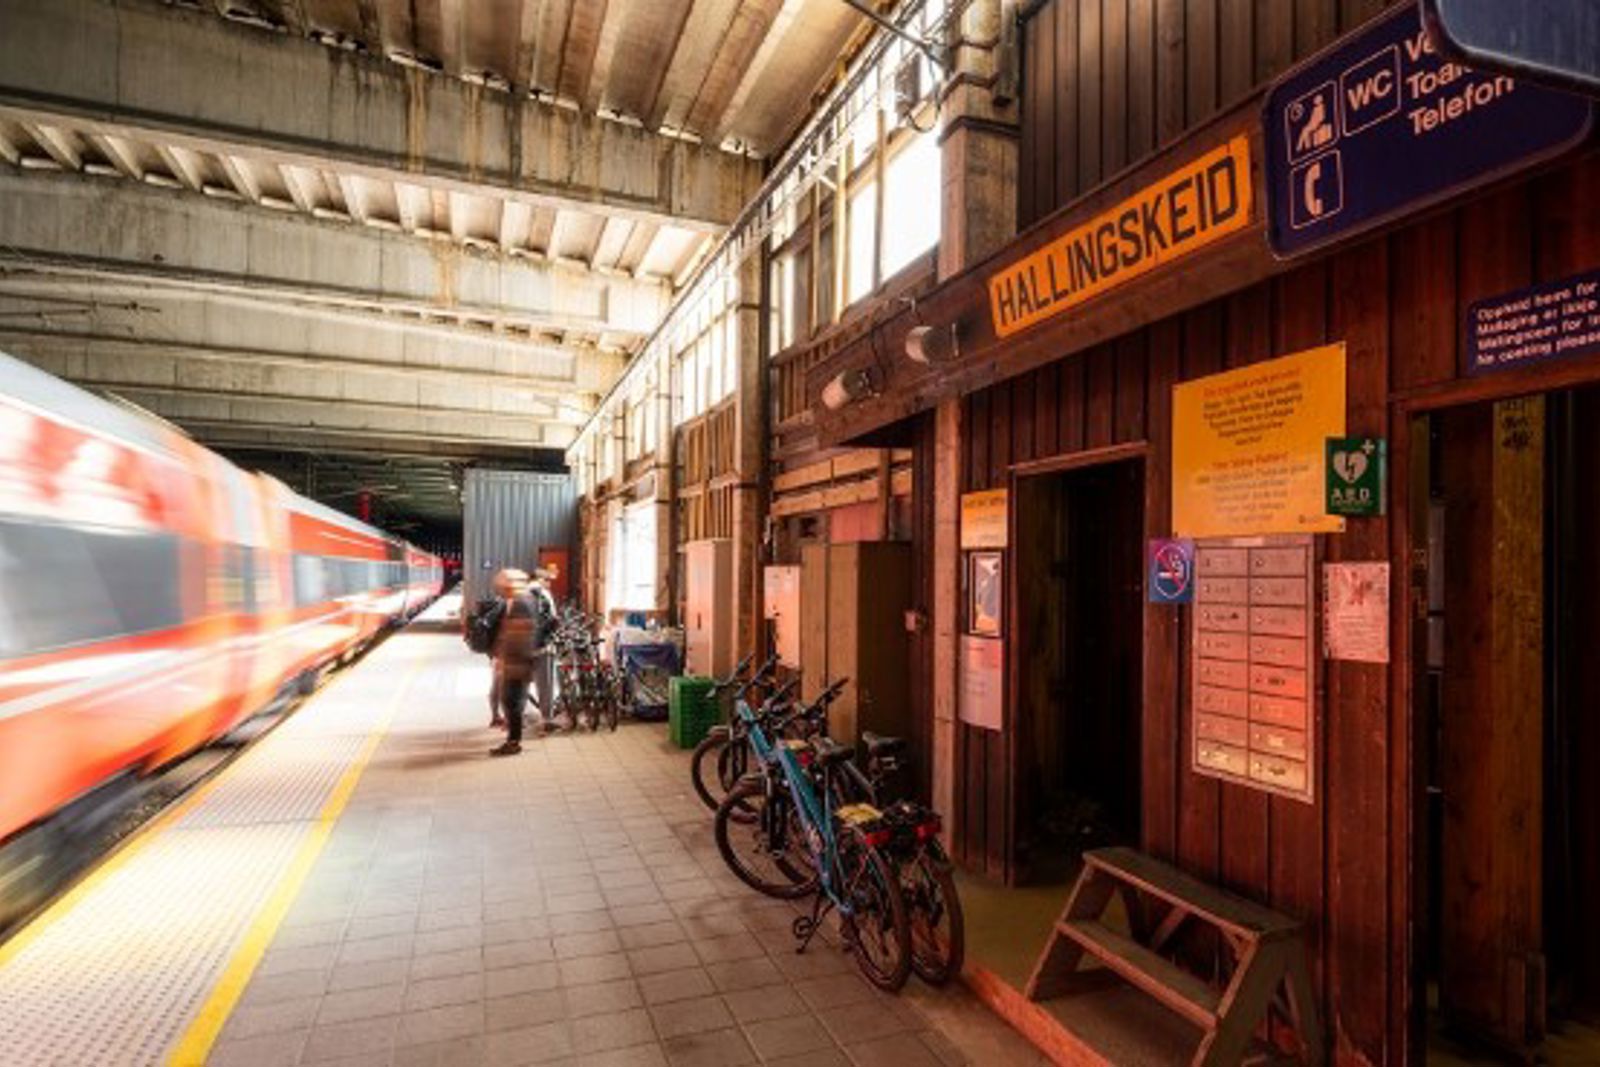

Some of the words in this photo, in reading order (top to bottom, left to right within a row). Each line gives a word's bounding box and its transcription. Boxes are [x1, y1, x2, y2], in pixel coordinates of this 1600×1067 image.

[1348, 69, 1393, 111] WC
[1406, 62, 1473, 98] Toa
[1408, 75, 1514, 135] Telefon
[996, 155, 1239, 327] HALLINGSKEID
[1562, 319, 1582, 333] for
[1499, 342, 1552, 362] cooking
